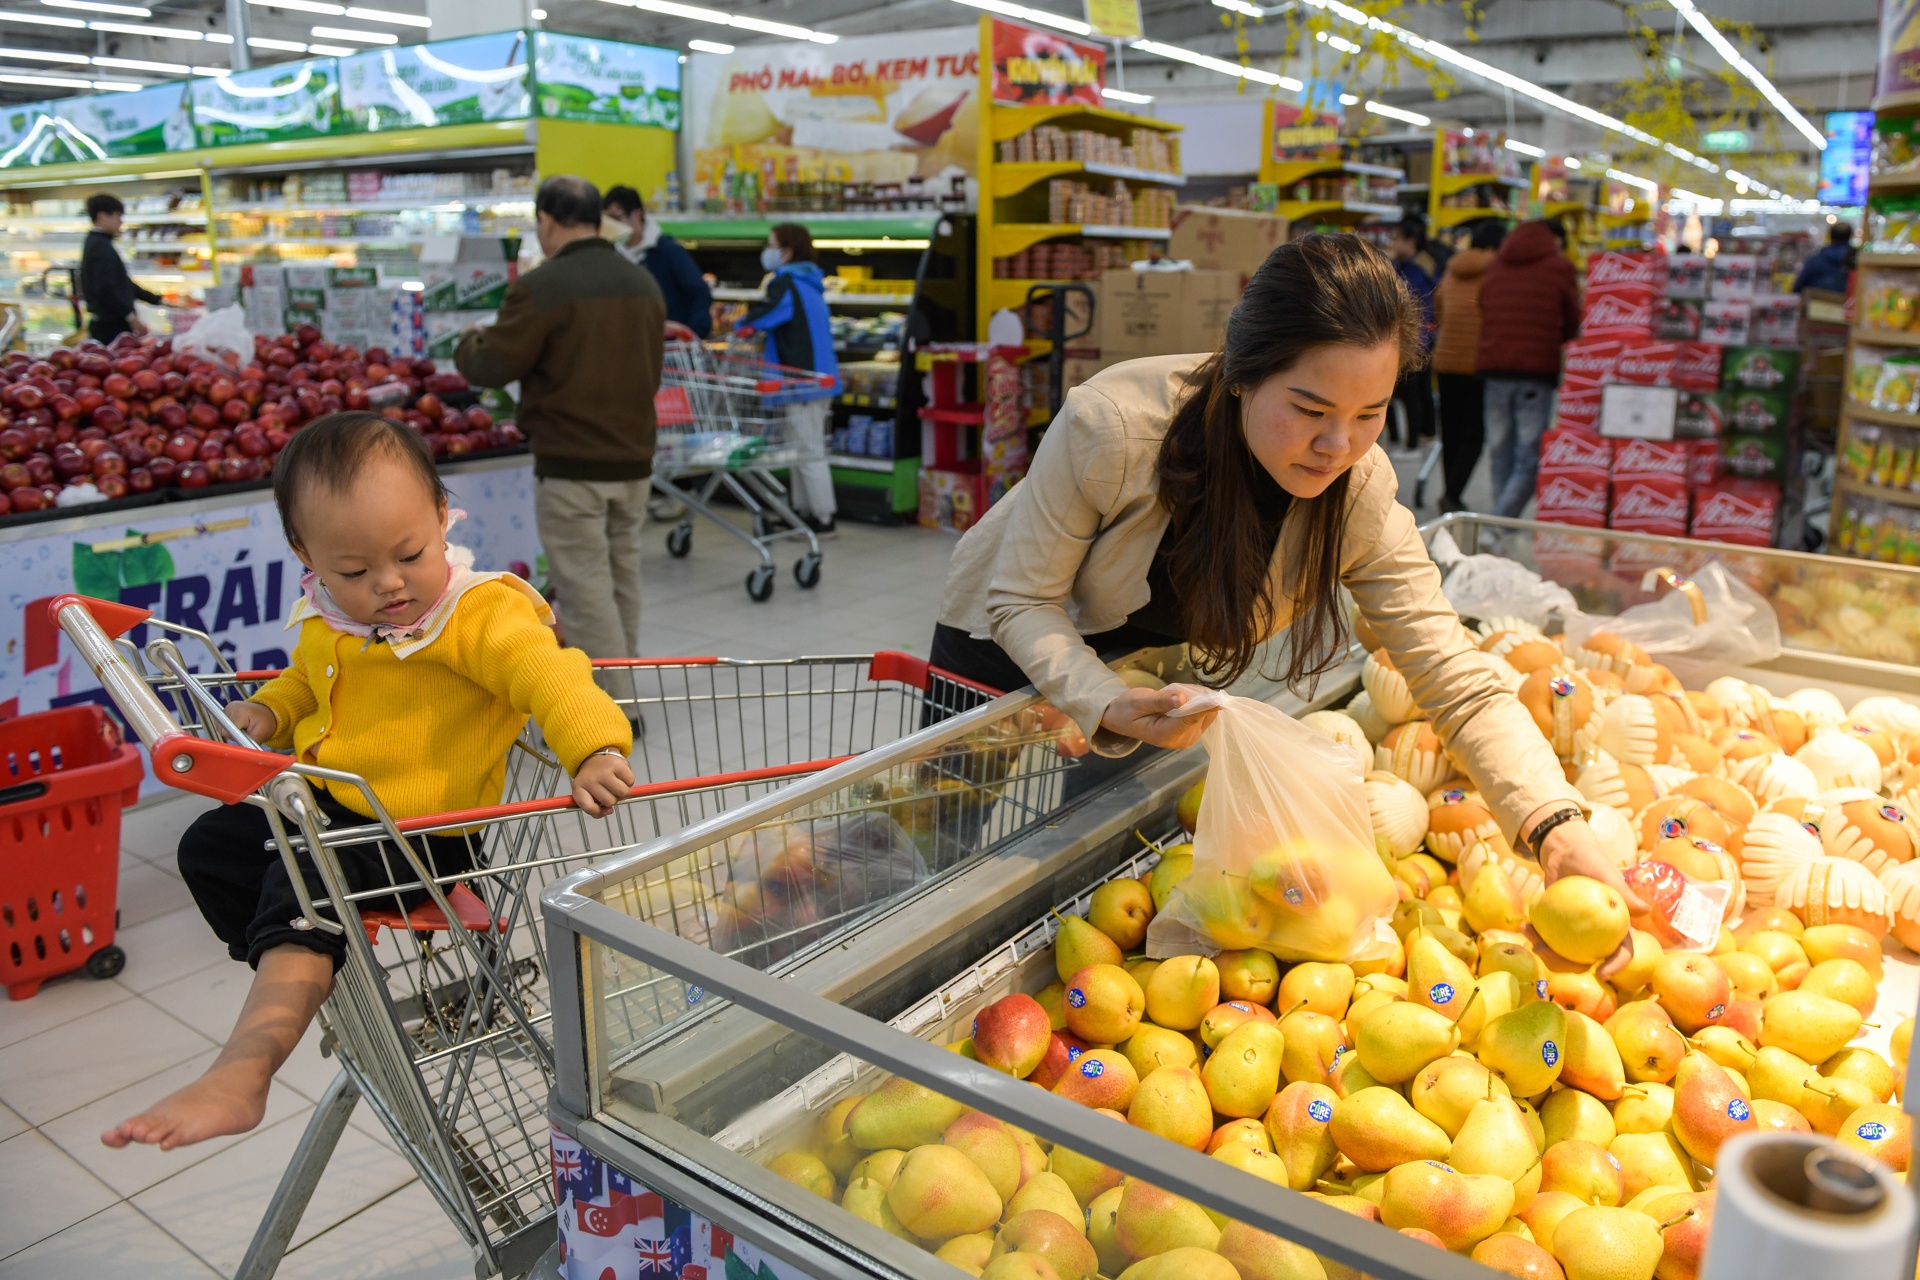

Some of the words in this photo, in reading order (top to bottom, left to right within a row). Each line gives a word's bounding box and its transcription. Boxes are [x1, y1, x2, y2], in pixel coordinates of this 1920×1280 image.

[729, 65, 773, 93] PHÔ
[876, 57, 927, 82] KEM
[119, 549, 284, 650] TRÁI
